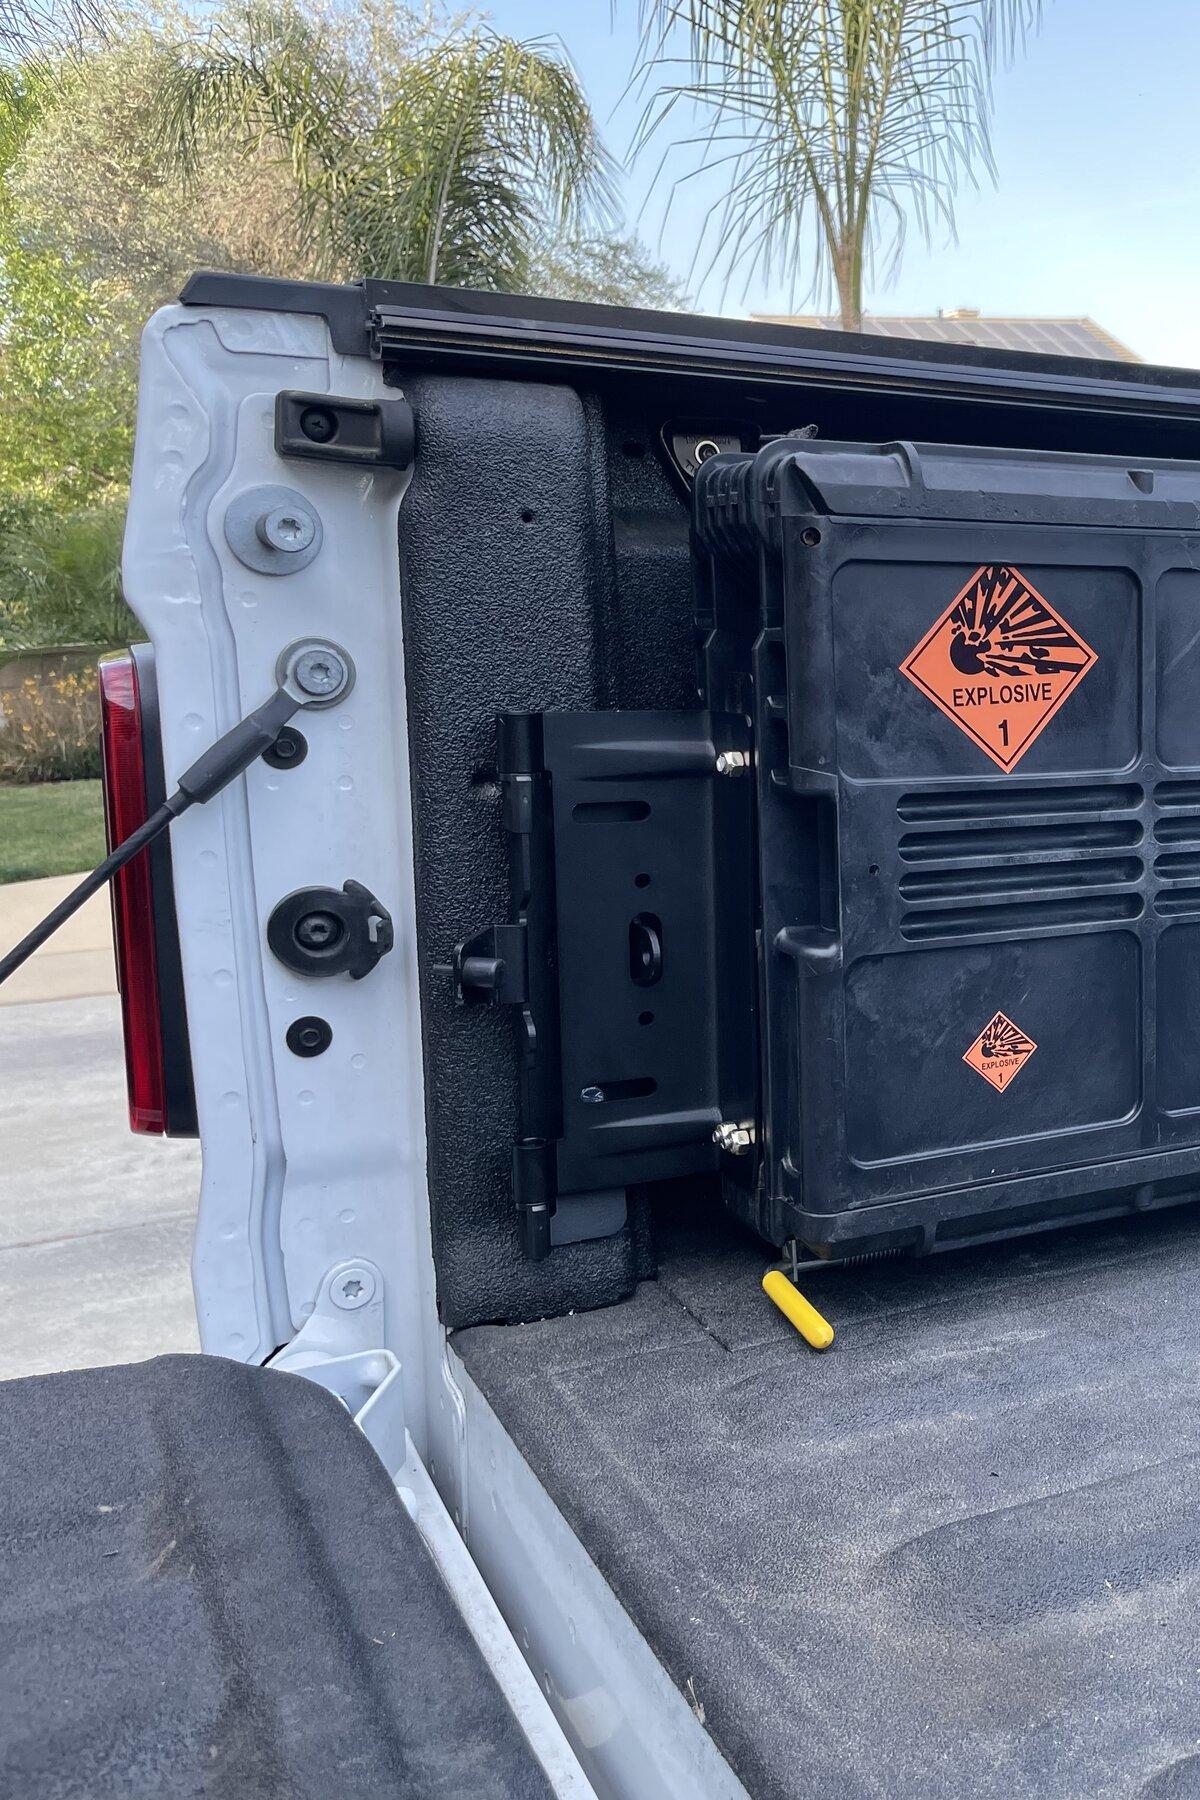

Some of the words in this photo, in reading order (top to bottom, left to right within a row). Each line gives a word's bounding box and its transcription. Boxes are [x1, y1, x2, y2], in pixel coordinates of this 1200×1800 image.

[952, 682, 1053, 707] EXPLOSIVE
[997, 719, 1009, 747] 1
[981, 1057, 1020, 1071] EXPLOSIVE
[998, 1072, 1003, 1084] 1
